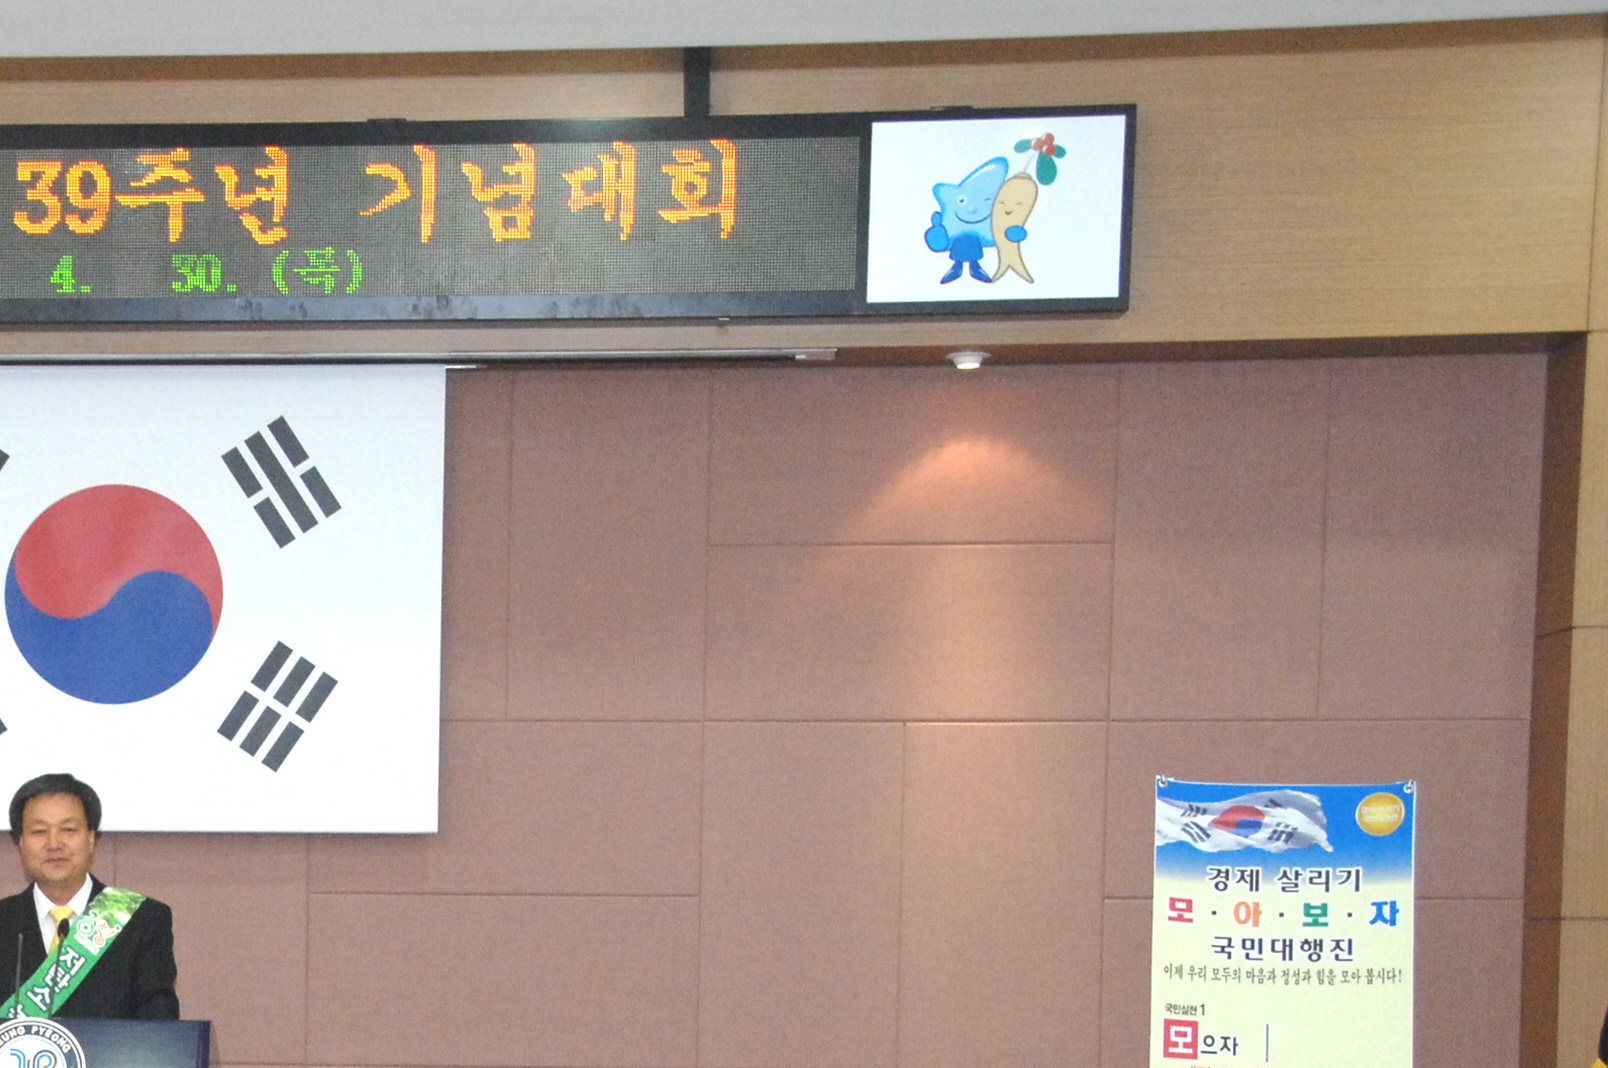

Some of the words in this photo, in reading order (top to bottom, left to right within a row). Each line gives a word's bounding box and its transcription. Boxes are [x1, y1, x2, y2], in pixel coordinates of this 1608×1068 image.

[14, 145, 289, 245] 39주년
[359, 138, 737, 243] 기념대회
[49, 253, 91, 295] 4.
[171, 253, 238, 294] 30.
[270, 246, 364, 296] (목)
[1207, 867, 1262, 893] 경제
[1275, 868, 1362, 894] 살리기
[1210, 935, 1354, 963] 국민대행진
[1163, 962, 1184, 981] 이제
[1186, 964, 1207, 983] 우리
[1211, 966, 1242, 984] 모두의
[1245, 967, 1277, 985] 마음과
[1280, 968, 1312, 986] 정성과
[1315, 968, 1337, 986] 힘을
[1340, 968, 1362, 985] 모아
[1199, 1003, 1206, 1017] 1
